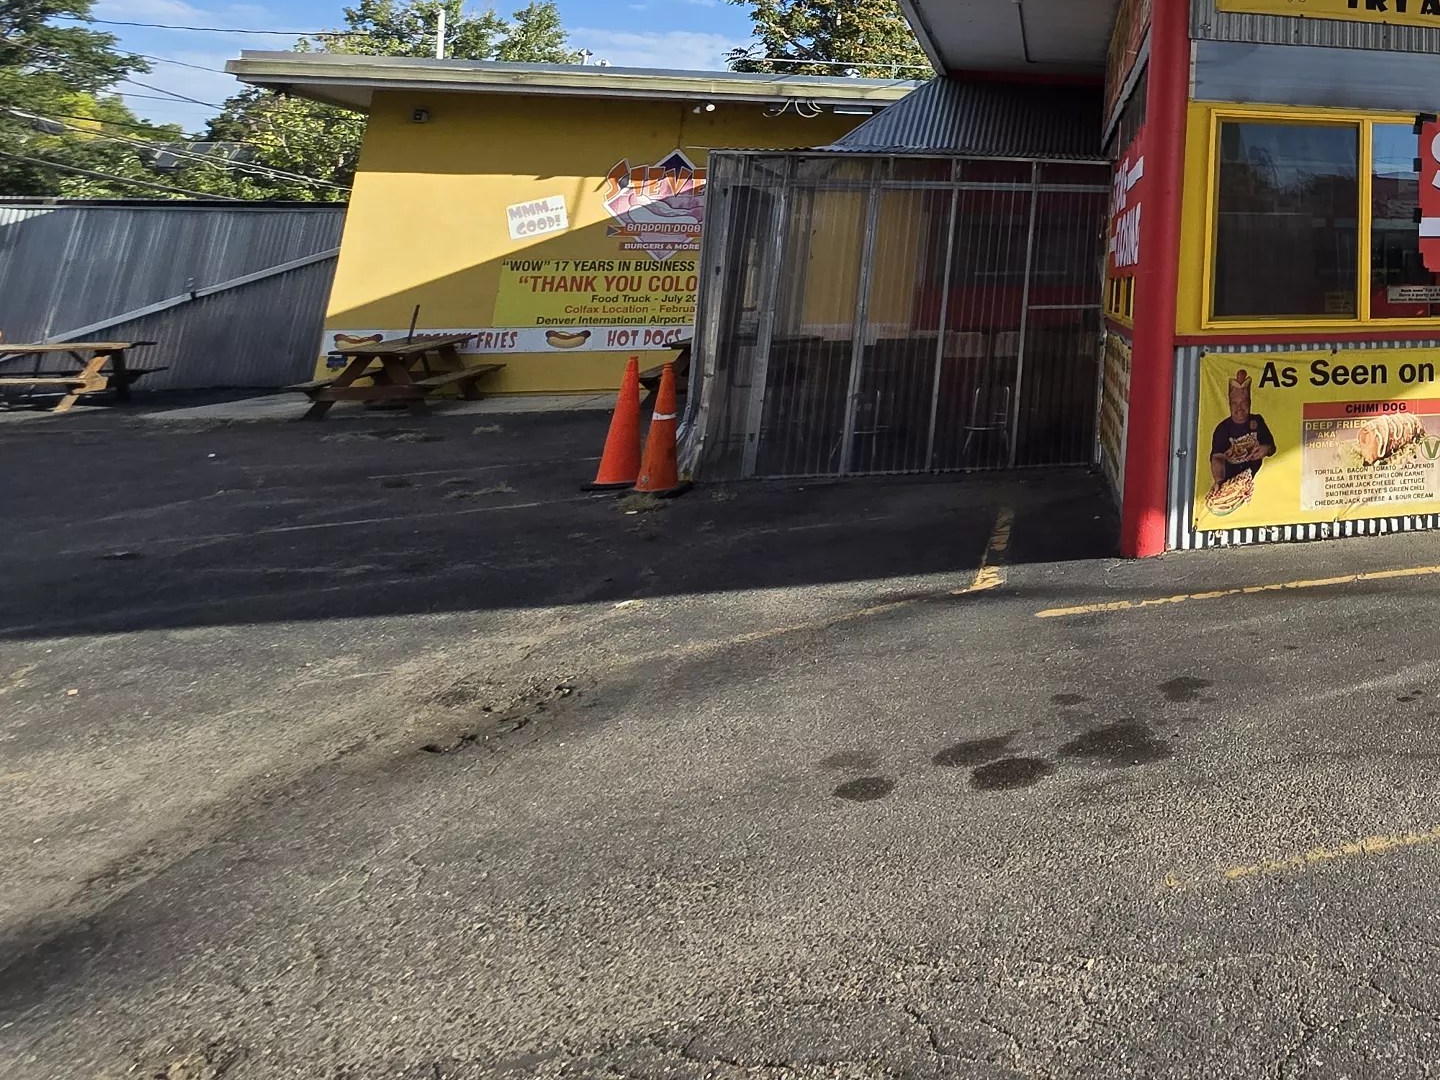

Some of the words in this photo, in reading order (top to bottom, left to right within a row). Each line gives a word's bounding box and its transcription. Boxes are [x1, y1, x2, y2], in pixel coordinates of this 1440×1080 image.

[516, 214, 561, 235] GOOD!
[503, 260, 550, 271] "WOW"
[554, 261, 568, 271] 17
[574, 260, 614, 272] YEARS
[618, 261, 631, 271] IN
[634, 260, 695, 272] BUSINESS
[519, 275, 598, 293] "THANK
[605, 275, 642, 293] YOU
[591, 295, 620, 303] Food
[622, 294, 651, 303] Truck
[661, 294, 683, 305] July
[564, 305, 599, 314] Colfax
[603, 305, 649, 314] Location
[536, 316, 576, 325] Denver
[578, 315, 646, 325] International
[649, 315, 686, 326] Airport
[476, 332, 518, 349] FRIES
[606, 330, 639, 347] HOT
[1258, 361, 1298, 389] As
[1309, 359, 1387, 387] Seen
[1398, 362, 1435, 383] on
[1346, 403, 1379, 413] CHIMI
[1382, 402, 1407, 412] DOG
[1305, 421, 1333, 431] DEEP
[1424, 440, 1440, 458] V
